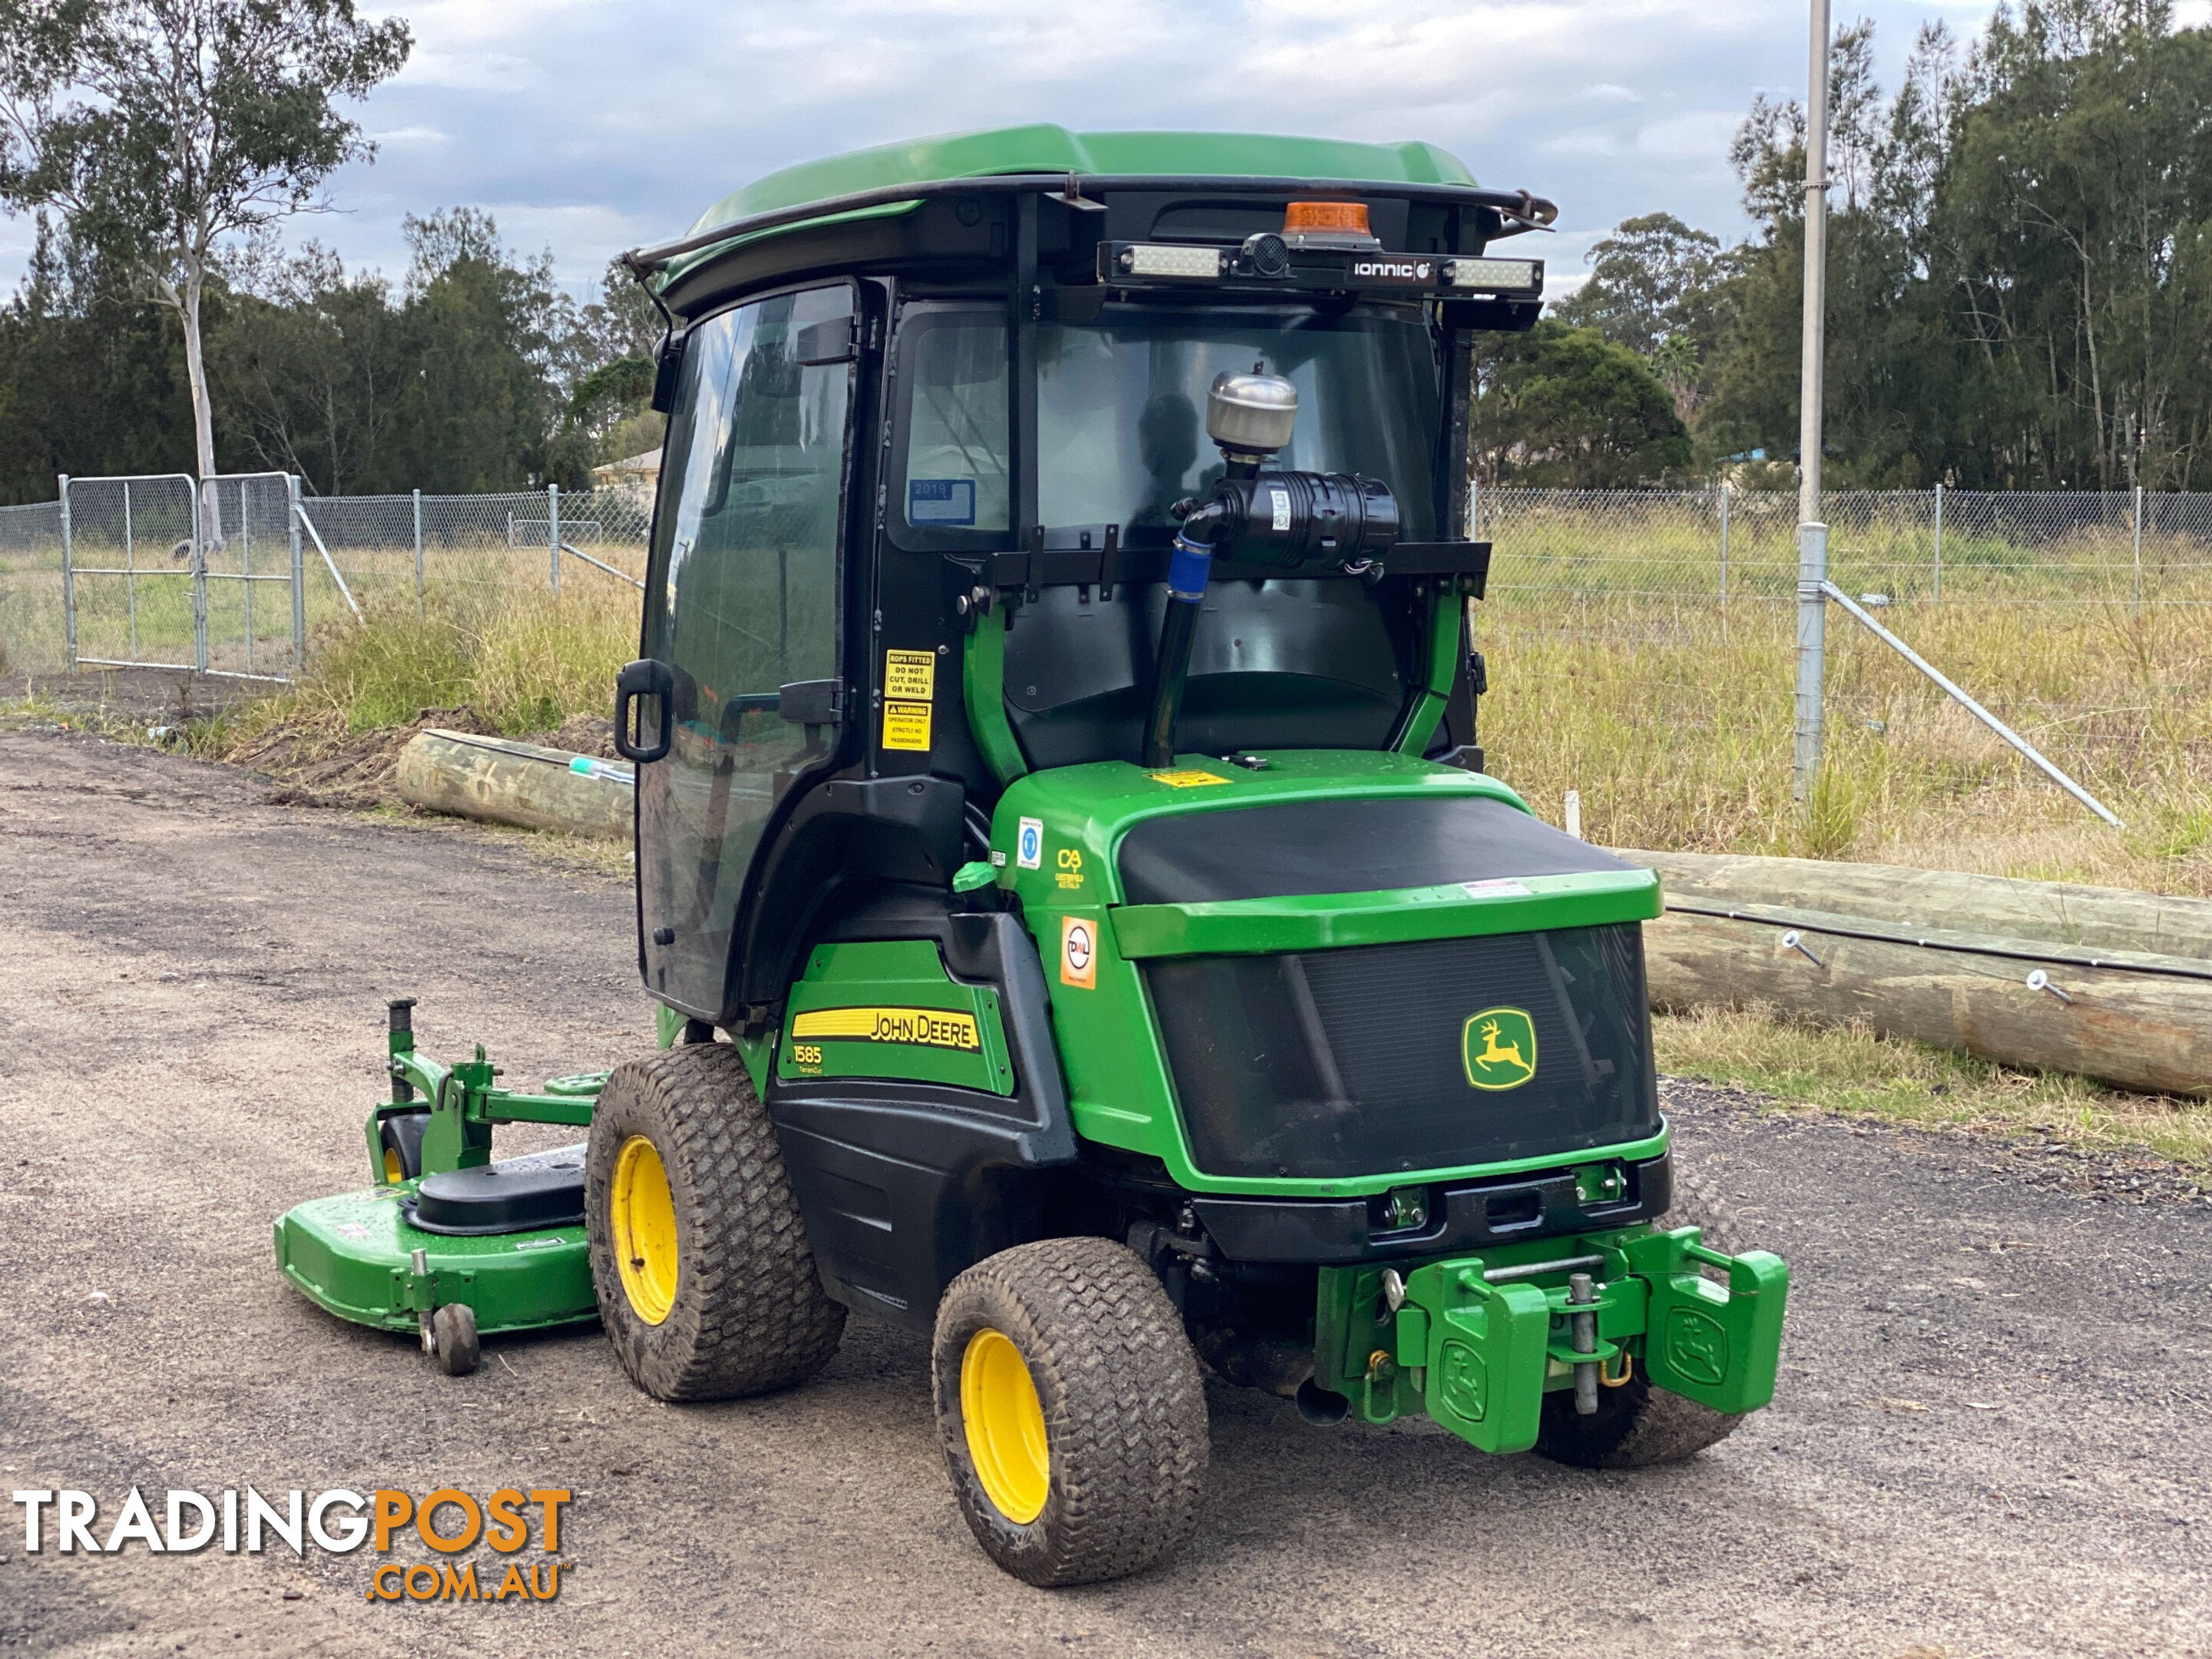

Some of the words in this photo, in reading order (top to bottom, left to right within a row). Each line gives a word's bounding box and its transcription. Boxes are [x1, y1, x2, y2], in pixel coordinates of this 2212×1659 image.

[908, 656, 931, 664] FITTED
[897, 706, 926, 715] WARNING
[871, 1012, 914, 1039] JOHN
[917, 1015, 972, 1045] DEERE
[793, 1045, 822, 1064] 1585
